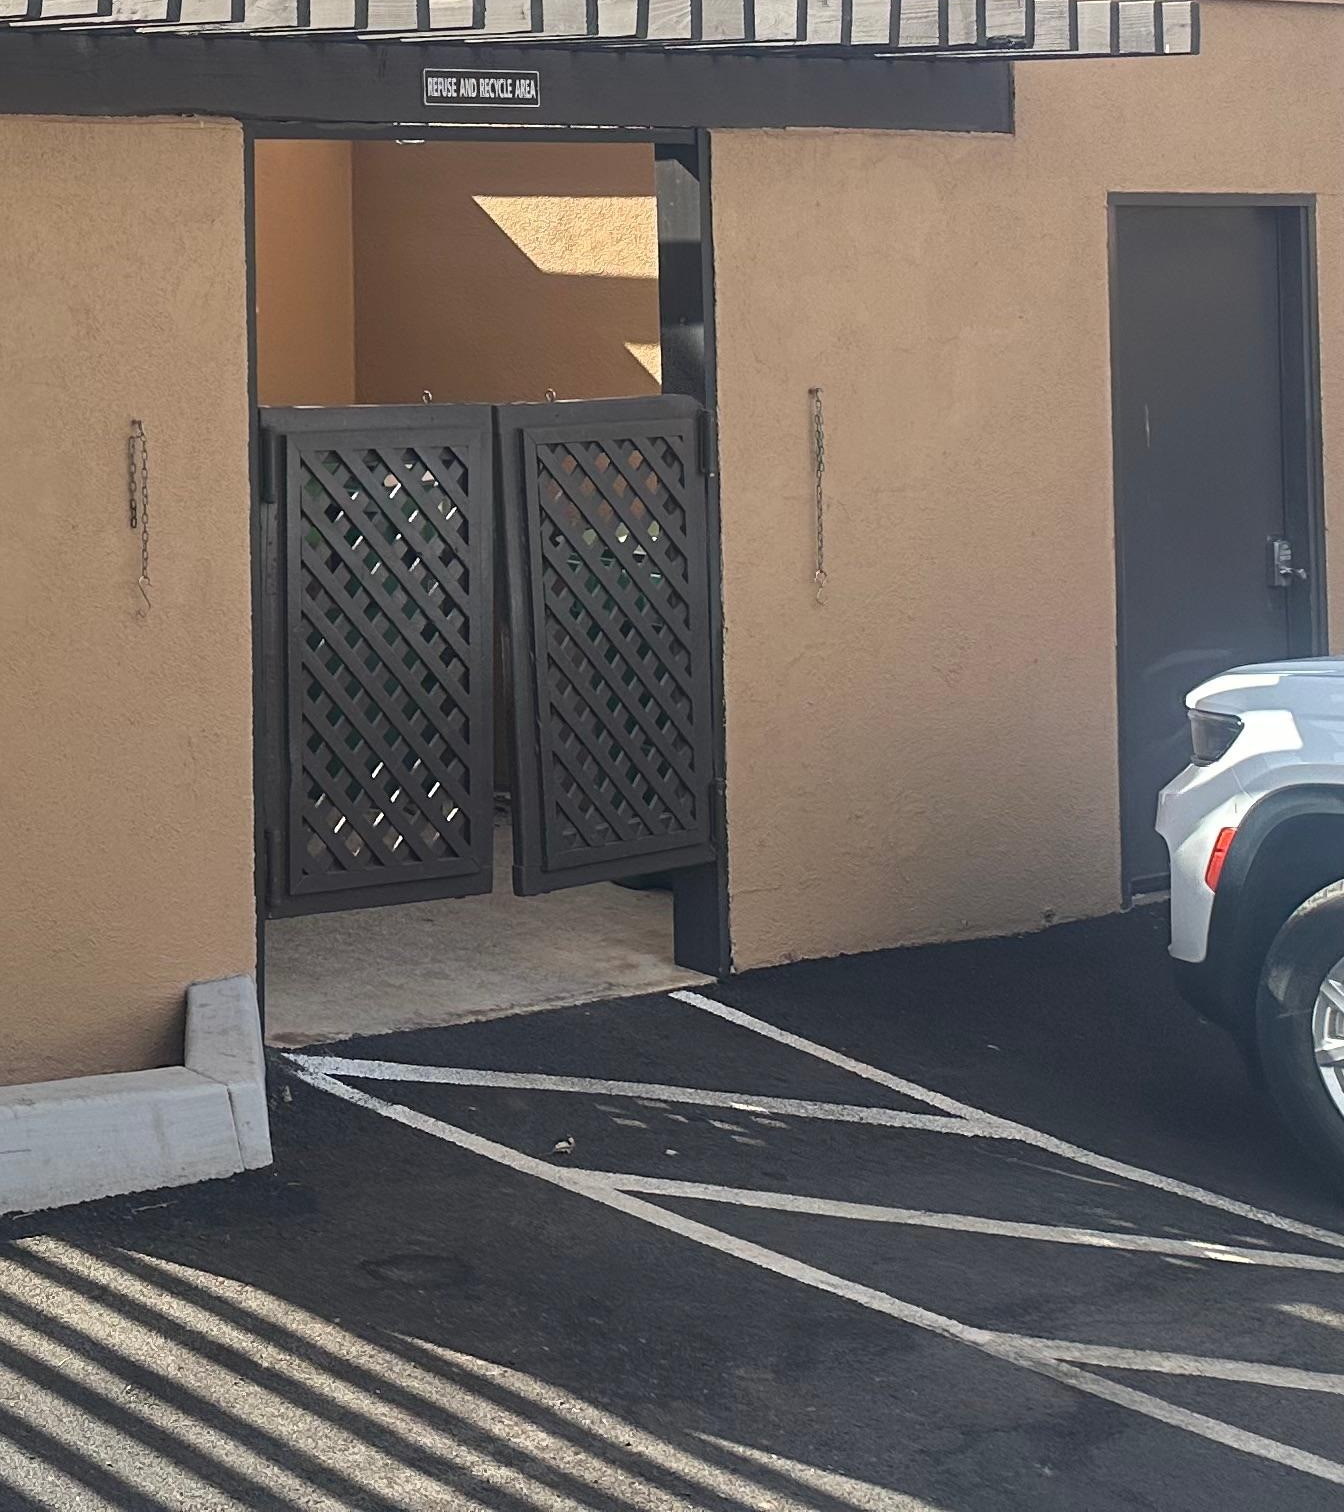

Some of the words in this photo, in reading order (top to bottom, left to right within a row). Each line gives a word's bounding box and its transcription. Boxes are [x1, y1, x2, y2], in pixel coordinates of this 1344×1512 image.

[427, 77, 458, 97] REFUSE
[459, 78, 477, 98] AND
[479, 78, 513, 99] RECYCLE
[515, 79, 537, 99] AREA
